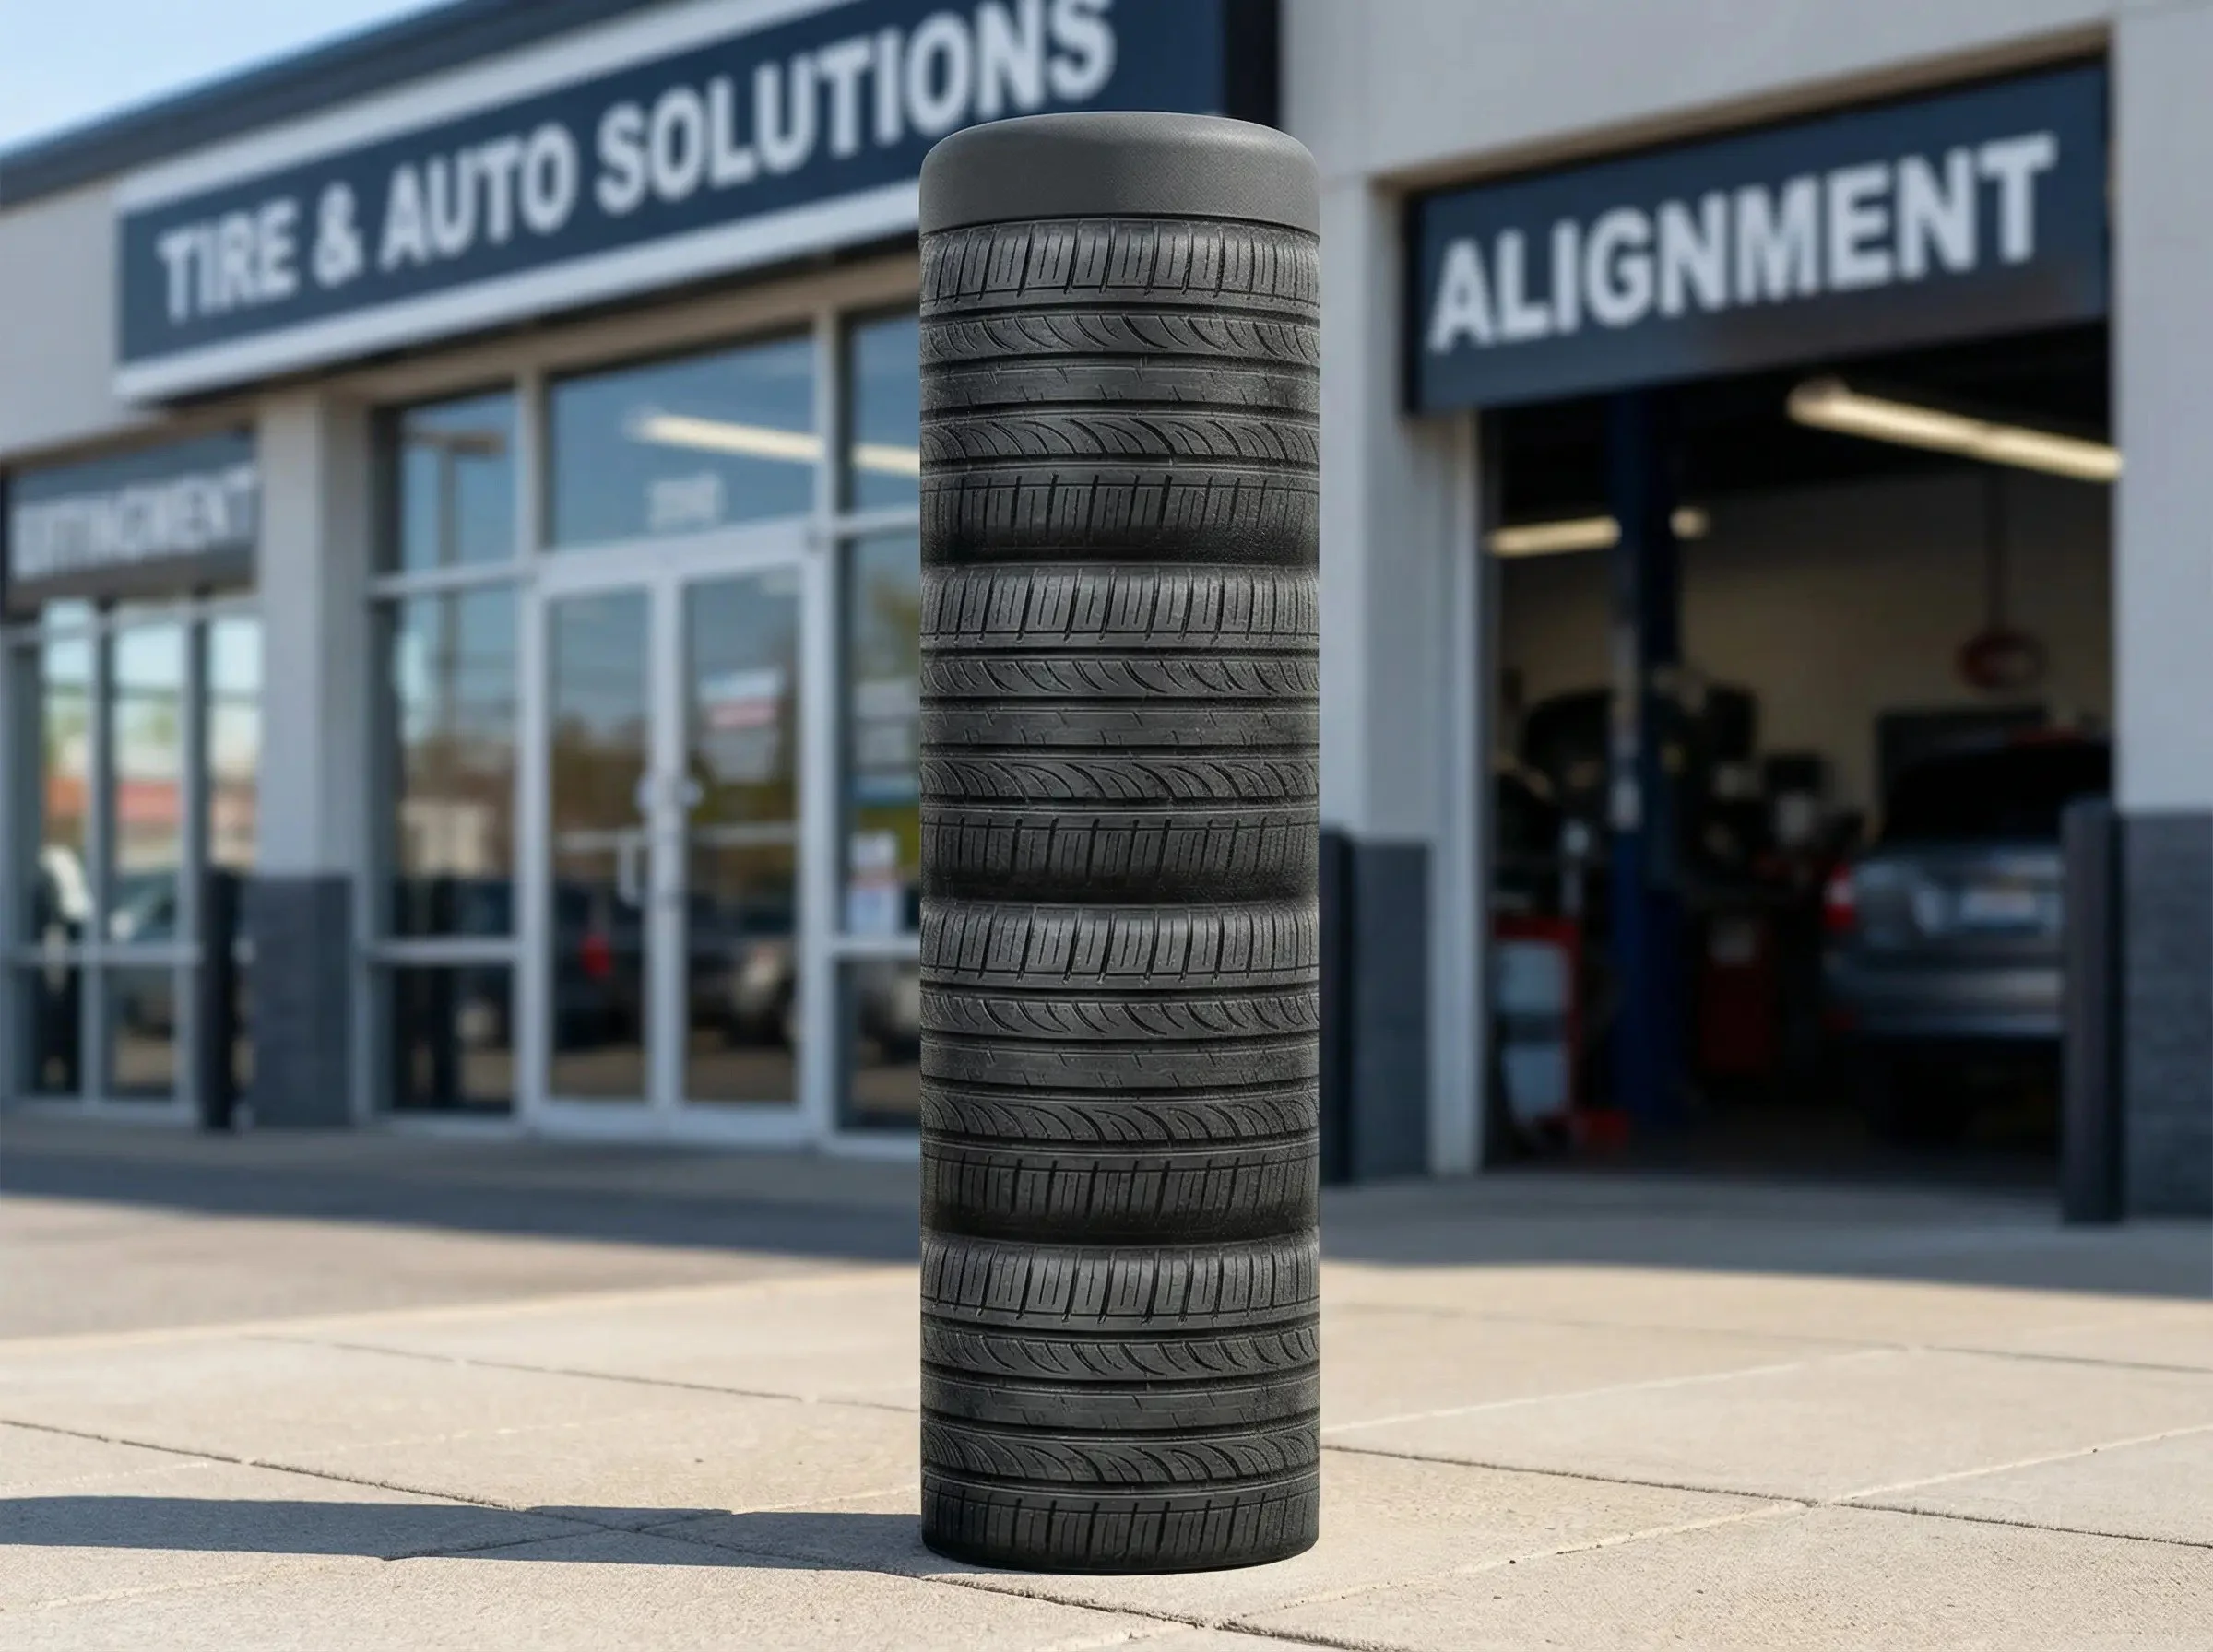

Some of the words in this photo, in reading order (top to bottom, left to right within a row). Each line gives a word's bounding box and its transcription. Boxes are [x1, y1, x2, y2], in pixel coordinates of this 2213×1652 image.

[159, 196, 300, 320] TIRE
[314, 183, 365, 287] &
[381, 124, 579, 271] AUTO
[596, 0, 1116, 215] SOLUTIONS
[1428, 133, 2058, 353] ALIGNMENT
